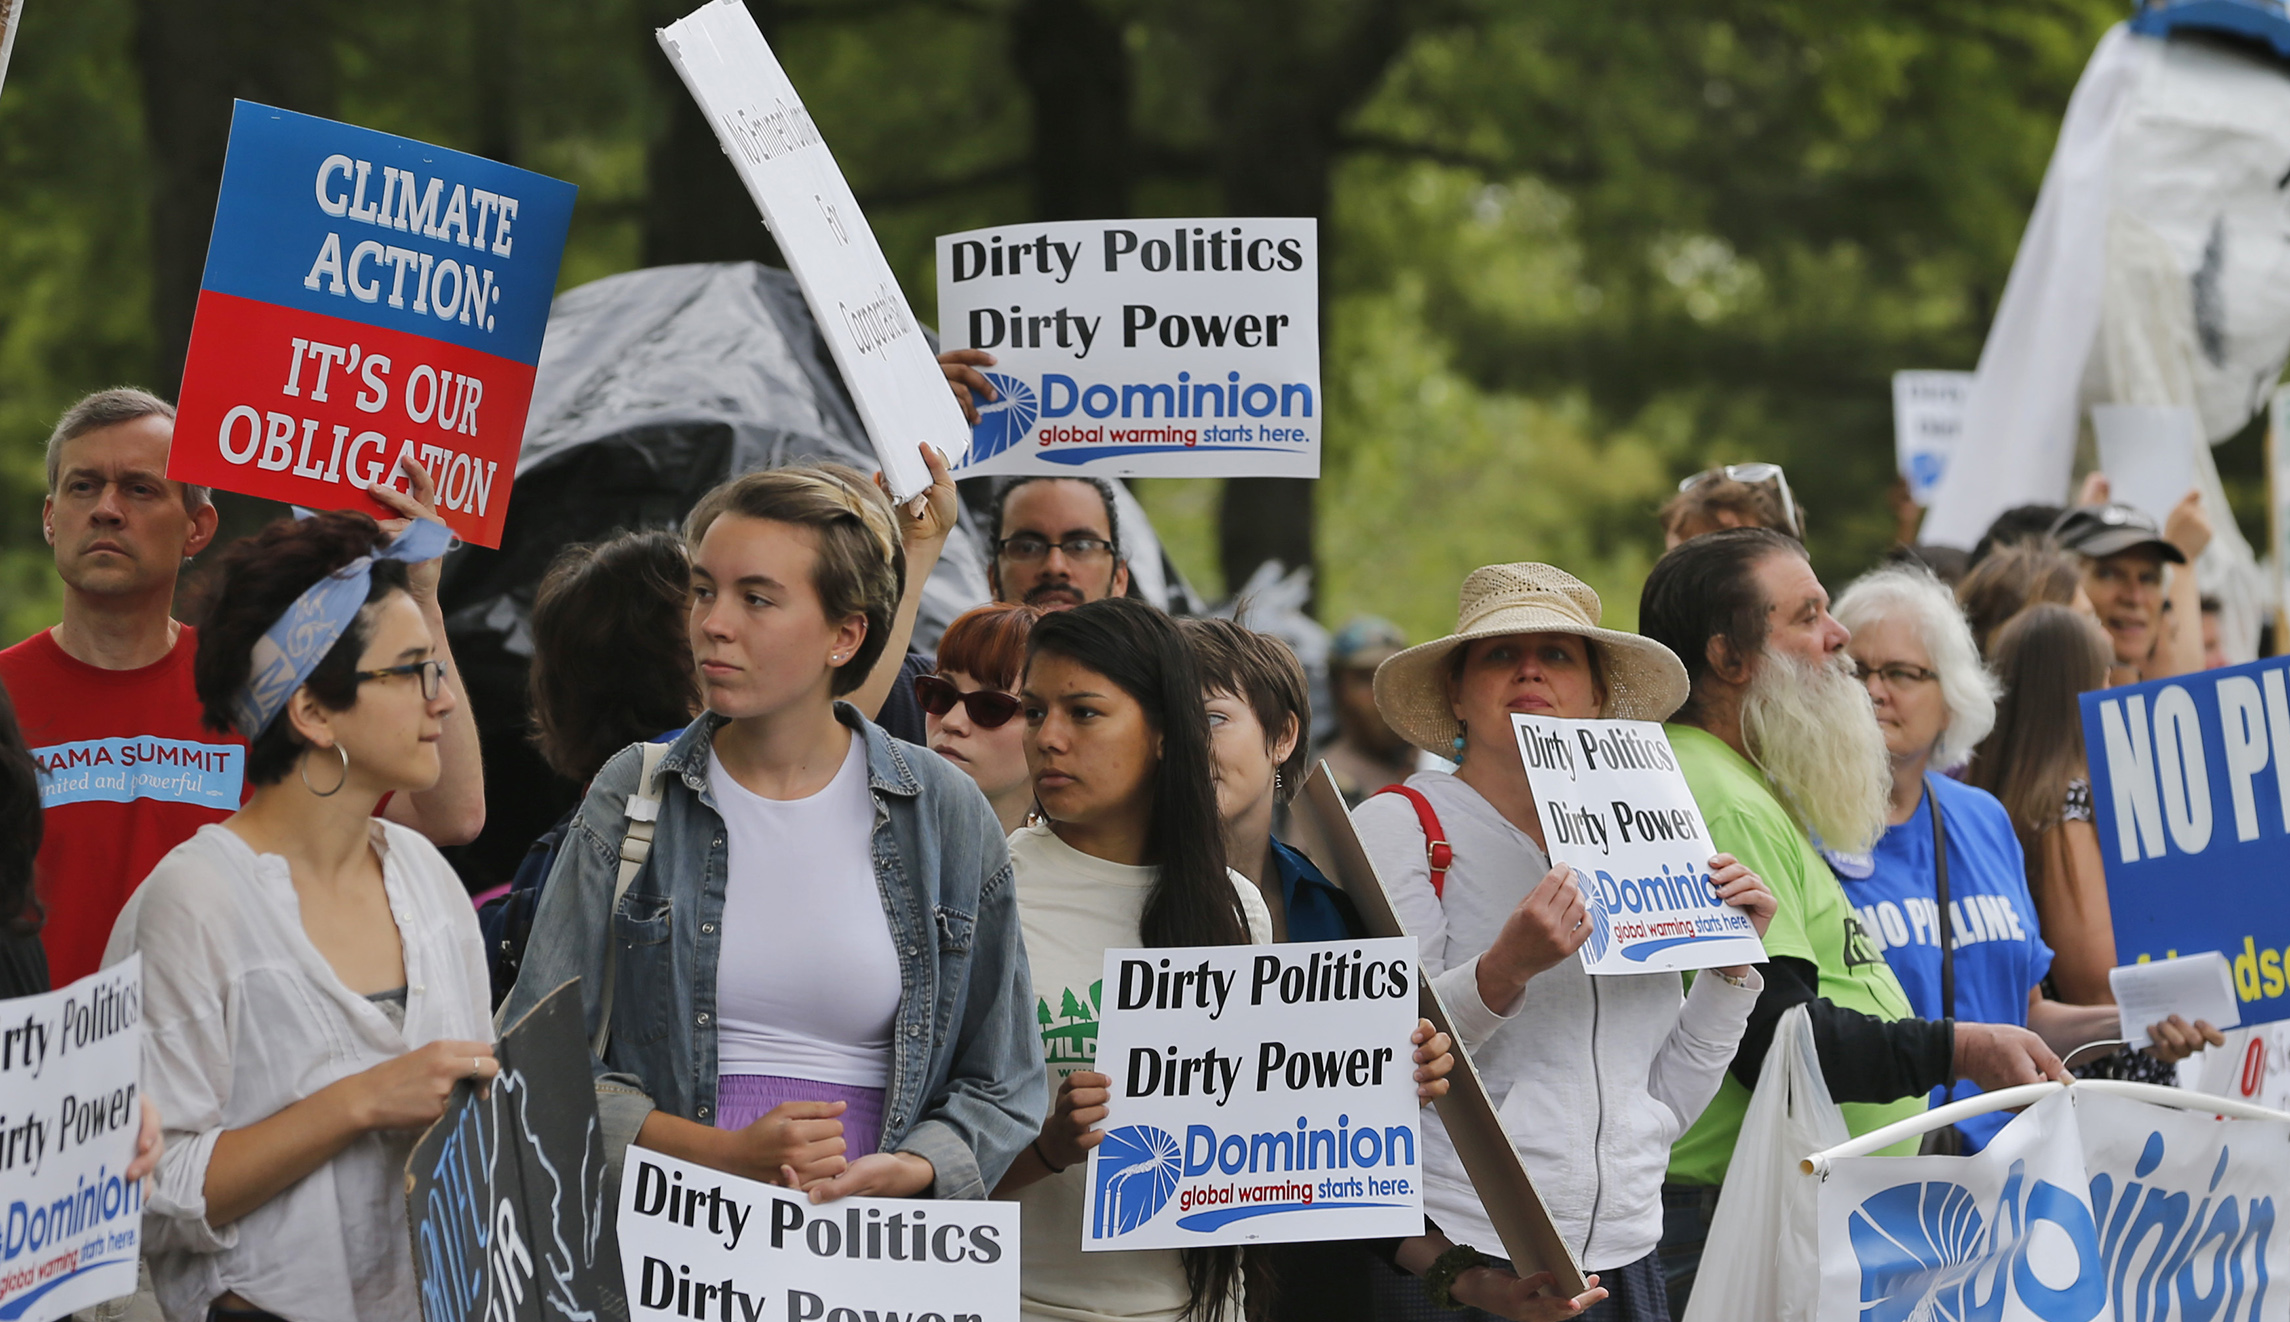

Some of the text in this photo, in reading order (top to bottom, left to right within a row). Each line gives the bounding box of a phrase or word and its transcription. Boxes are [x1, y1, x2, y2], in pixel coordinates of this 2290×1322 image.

[722, 113, 762, 166] No
[315, 154, 519, 258] CLIMATE
[304, 232, 501, 333] ACTION:
[951, 227, 1303, 284] Dirty Politics
[968, 305, 1101, 359] Dirty
[1122, 304, 1290, 348] Power
[282, 337, 484, 437] IT'S OUR
[1040, 370, 1313, 419] Dominion
[217, 404, 498, 518] OBLIGATION
[1038, 424, 1311, 448] global warming starts here.
[120, 742, 231, 773] SUMMIT
[1520, 724, 1675, 782] Dirty Politics
[2099, 683, 2214, 865] NO
[95, 771, 126, 791] and
[129, 772, 203, 797] powerful
[1547, 800, 1700, 856] Dirty Power
[1594, 861, 1725, 916] Dominio
[1613, 912, 1752, 944] global warming starts here.
[1855, 900, 1910, 952] NO
[1902, 894, 2027, 951] PILINE
[1116, 949, 1409, 1020] Dirty Politics
[60, 976, 140, 1056] Politics
[1125, 1041, 1393, 1107] Dirty Power
[58, 1082, 136, 1153] Power
[1183, 1113, 1415, 1178] Dominion
[4, 1165, 140, 1261] Dominion
[633, 1161, 1002, 1264] Dirty Politics
[1179, 1176, 1415, 1212] global warming starts here.
[37, 1248, 79, 1280] warming
[79, 1235, 105, 1262] starts
[639, 1255, 766, 1322] Dirty
